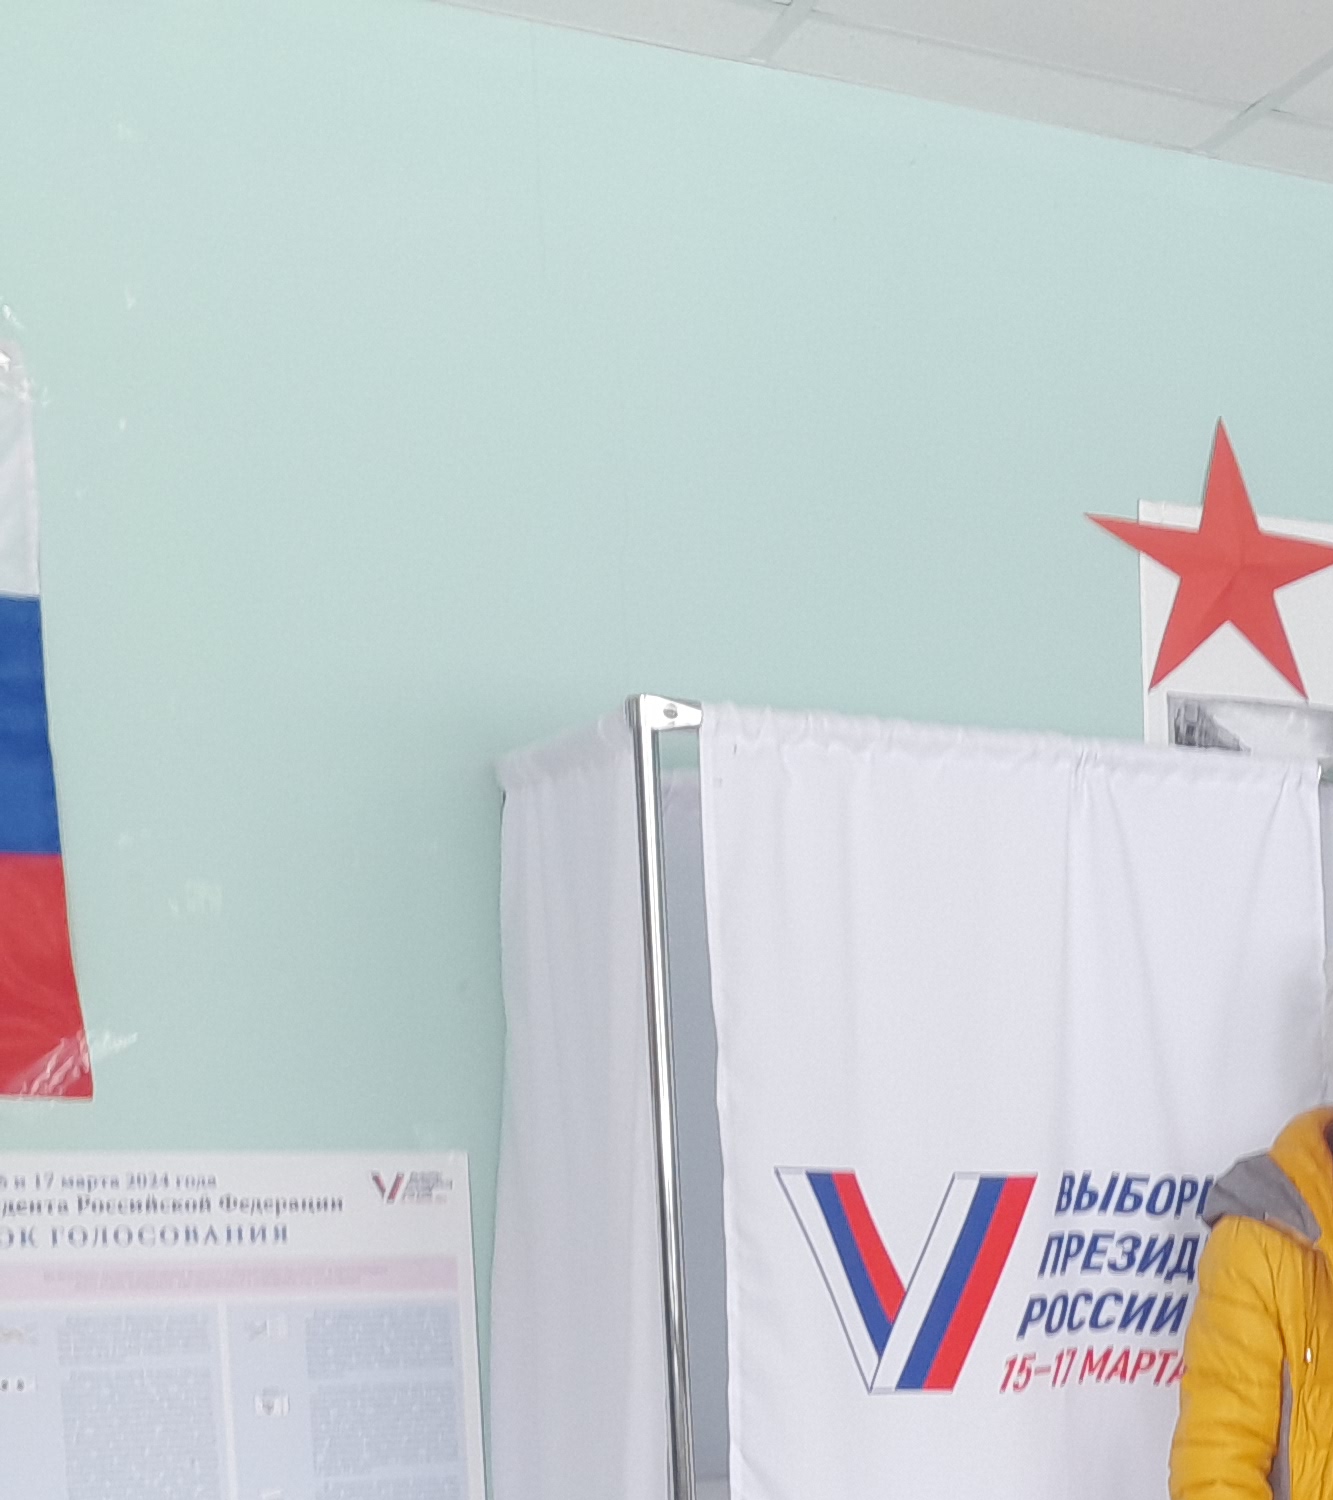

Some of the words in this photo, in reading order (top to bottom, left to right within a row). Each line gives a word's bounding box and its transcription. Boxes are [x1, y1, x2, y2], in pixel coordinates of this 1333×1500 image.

[35, 1172, 54, 1191] 17
[61, 1175, 120, 1193] марта
[126, 1171, 169, 1191] 2024
[176, 1174, 217, 1191] года
[76, 1194, 212, 1216] Российской
[218, 1193, 344, 1218] Федерации
[51, 1223, 288, 1249] ГОЛОСОВАНИЯ
[1037, 1230, 1207, 1283] ПРЕЗИД
[1016, 1288, 1189, 1340] РОССИИ
